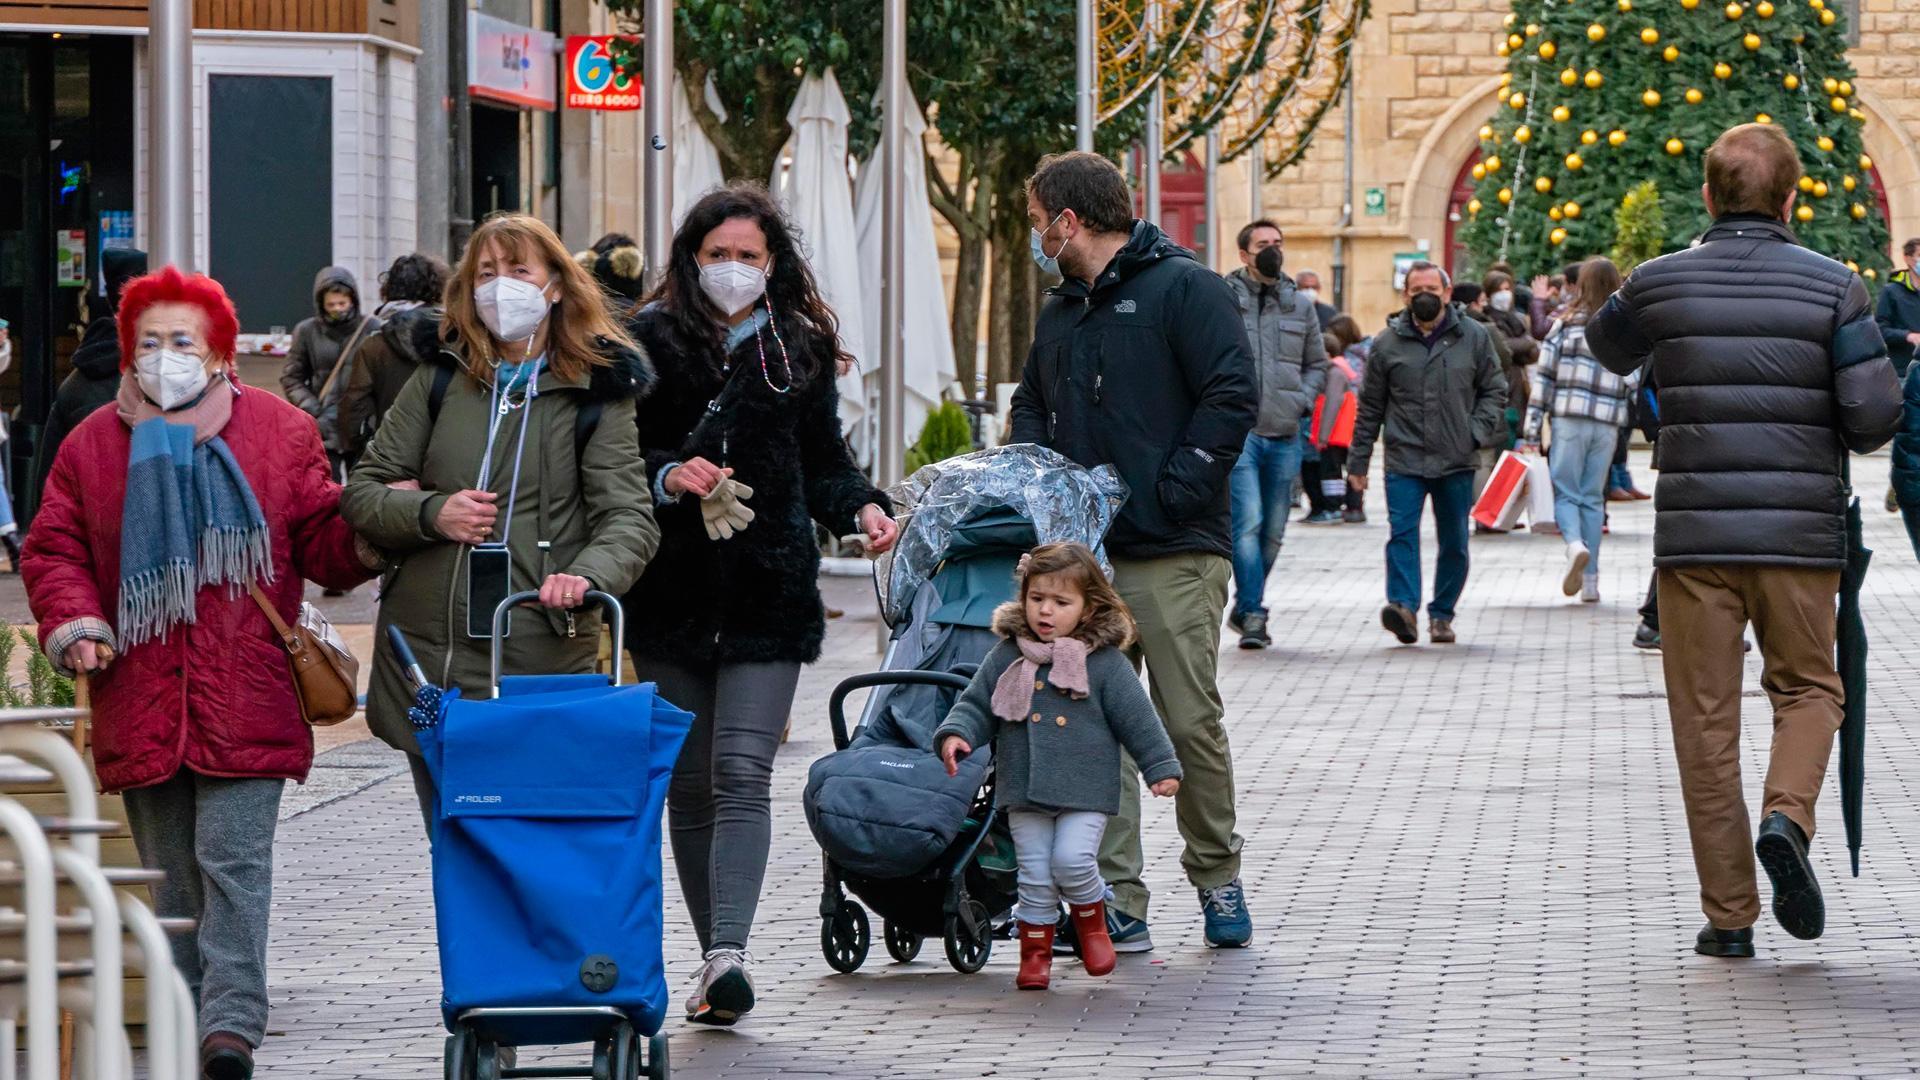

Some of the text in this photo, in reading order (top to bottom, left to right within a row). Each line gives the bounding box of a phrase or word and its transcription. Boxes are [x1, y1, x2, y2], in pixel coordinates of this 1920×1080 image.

[570, 94, 639, 107] EURO 6000
[466, 795, 502, 803] ROLSER
